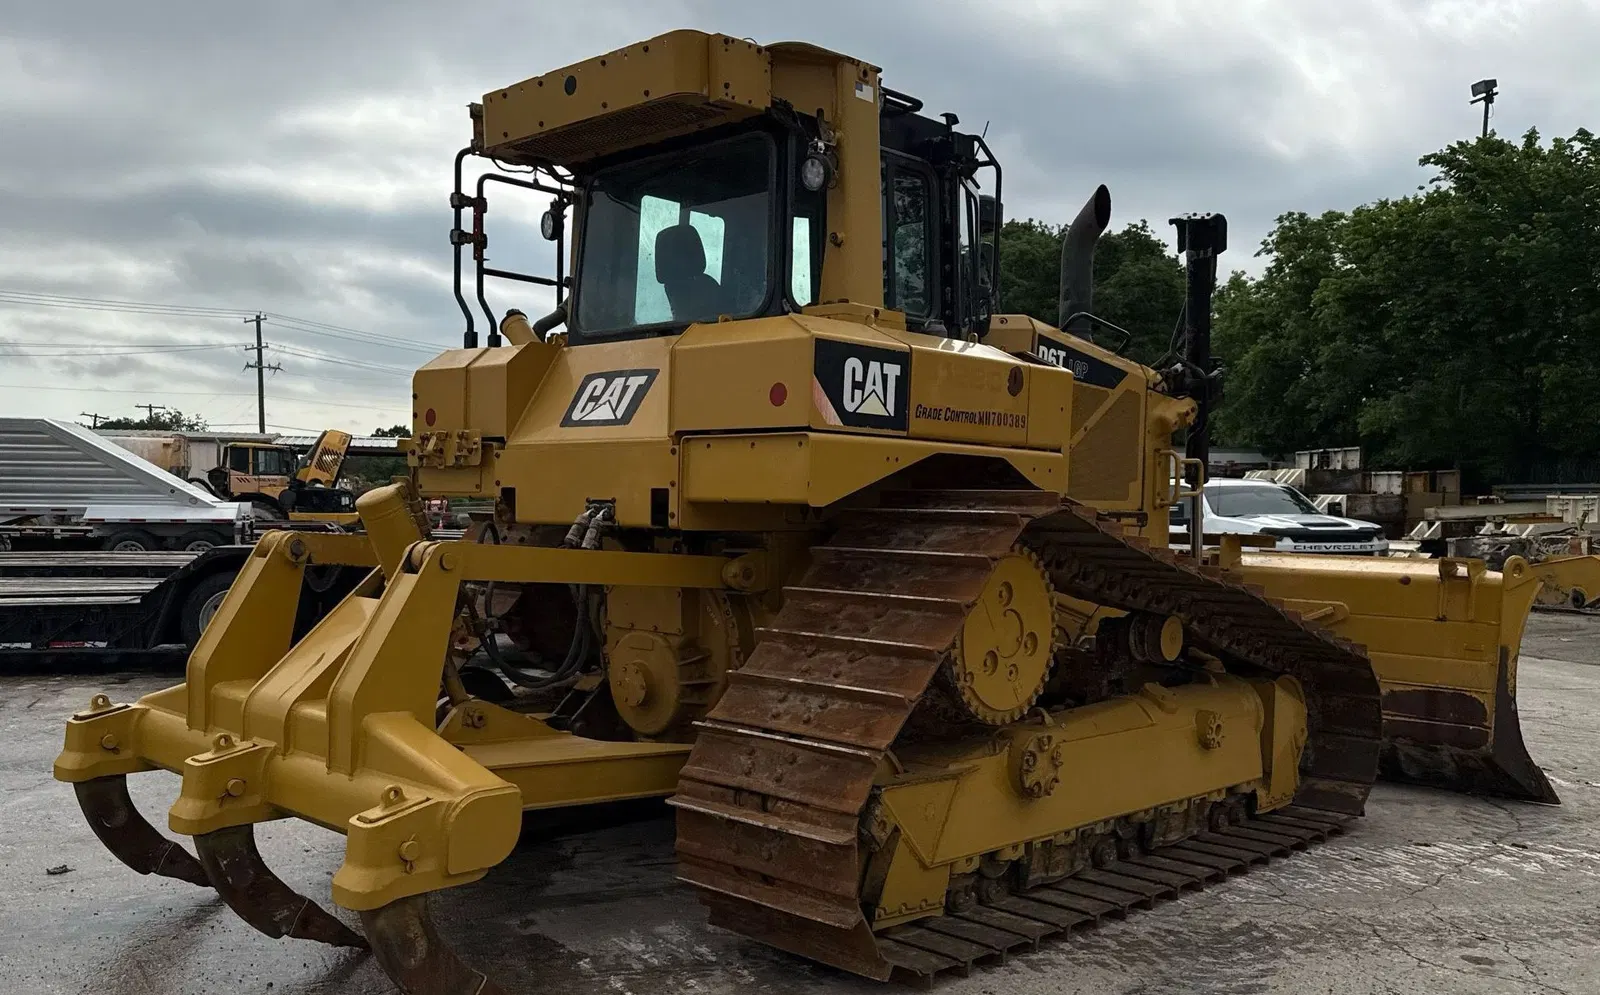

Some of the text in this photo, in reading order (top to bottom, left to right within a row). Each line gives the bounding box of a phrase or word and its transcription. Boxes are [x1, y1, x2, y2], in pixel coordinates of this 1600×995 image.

[571, 375, 649, 421] CAT
[842, 356, 902, 417] CAT
[915, 403, 977, 425] GRADE CONTROL
